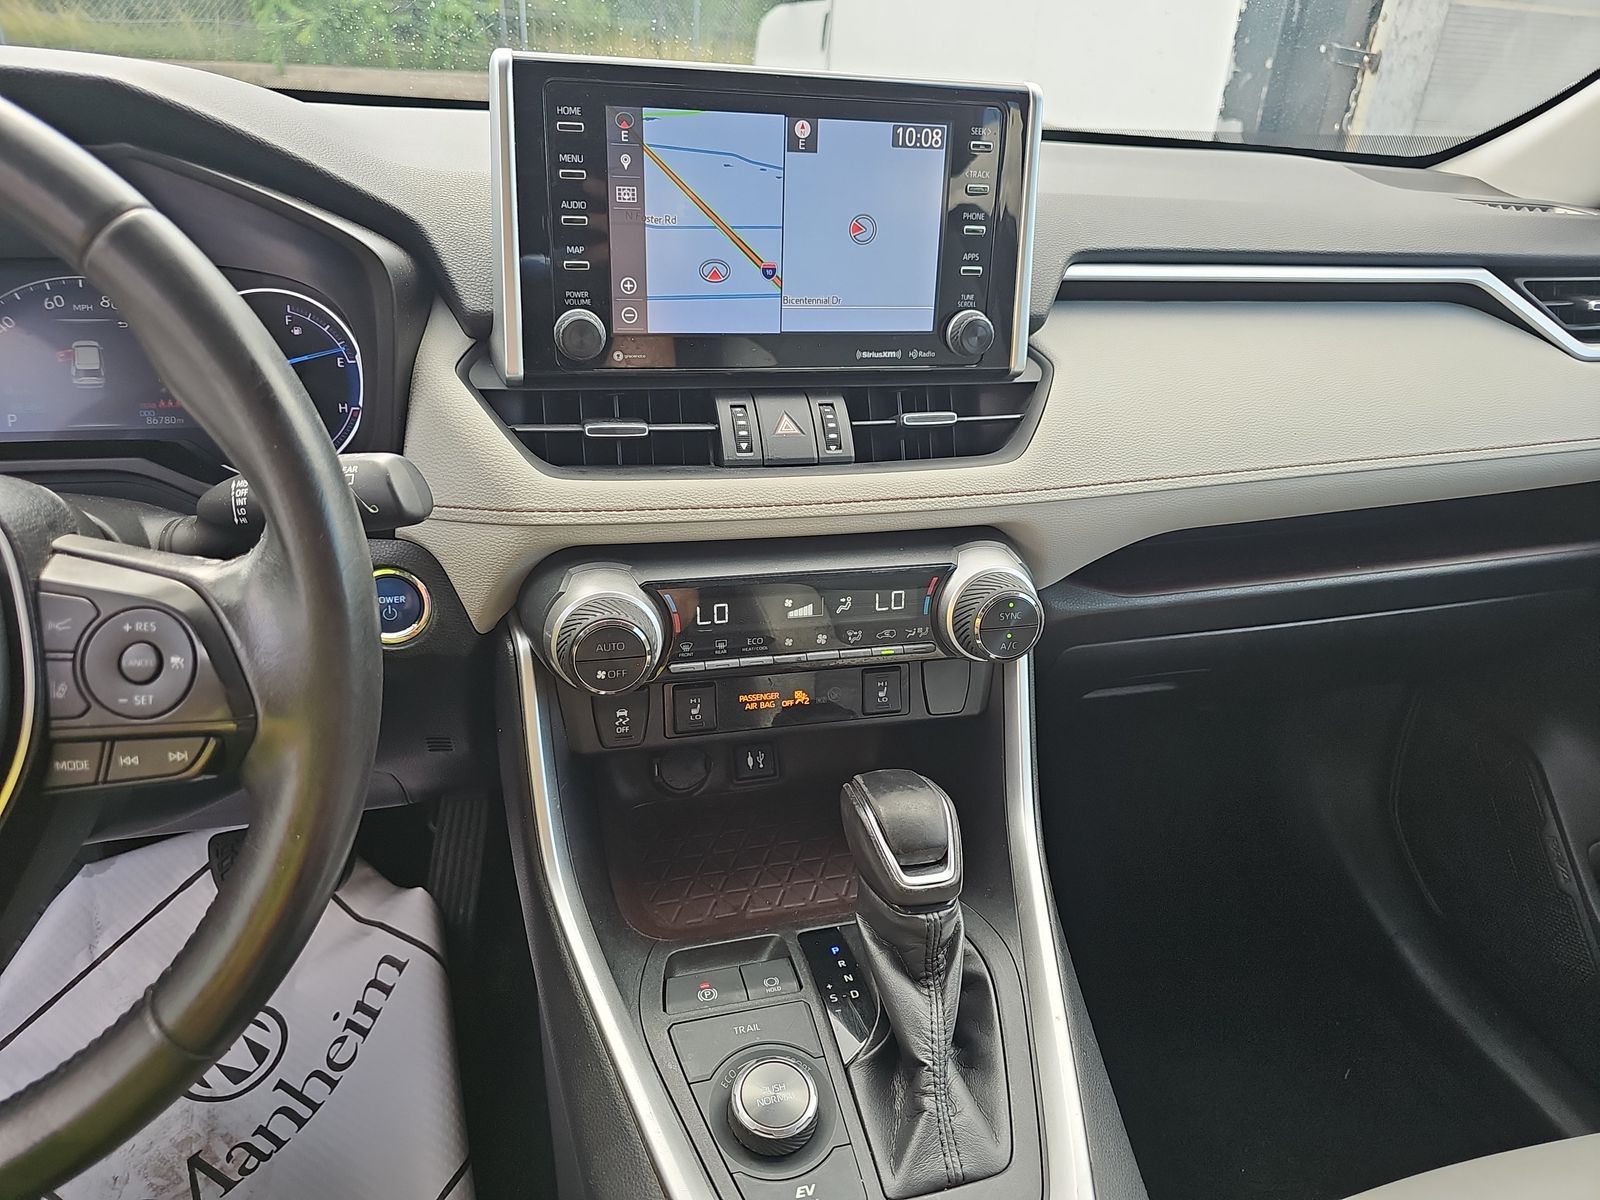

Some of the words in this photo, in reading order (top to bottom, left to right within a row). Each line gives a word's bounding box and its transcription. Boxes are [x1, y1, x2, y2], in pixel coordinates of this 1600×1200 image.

[556, 106, 582, 116] HOME
[621, 130, 629, 142] E
[896, 126, 943, 148] 10:08
[798, 139, 807, 150] E
[559, 153, 584, 163] MENU
[560, 200, 587, 210] AUDIO
[664, 215, 678, 225] Rd
[962, 212, 986, 221] PHONE
[566, 246, 585, 254] MAP
[962, 252, 980, 261] APPS
[765, 269, 773, 277] 10
[44, 295, 65, 310] 60
[564, 298, 592, 306] VOLUME
[782, 295, 831, 305] Bicentennial
[831, 296, 842, 305] Dr
[285, 315, 292, 325] F
[918, 350, 936, 358] Radio
[337, 357, 345, 368] E
[338, 403, 348, 414] H
[7, 414, 17, 427] P
[146, 417, 177, 425] 86780
[342, 465, 359, 474] EAR
[235, 488, 249, 497] OFF
[236, 497, 248, 506] INT
[236, 507, 247, 516] LO
[378, 595, 406, 604] OWER
[999, 611, 1022, 621] SYNC
[135, 621, 157, 632] RES
[747, 637, 764, 646] ECO
[1000, 641, 1018, 651] A/C
[595, 642, 625, 652] AUTO
[607, 670, 629, 679] OFF
[134, 695, 154, 705] SET
[738, 692, 780, 702] PASSENGER
[744, 702, 758, 710] AIR
[760, 701, 776, 709] BAG
[781, 699, 794, 708] OFF
[616, 726, 630, 734] OFF
[54, 760, 90, 771] MODE
[830, 946, 840, 955] P
[838, 959, 847, 968] R
[844, 974, 854, 983] N
[829, 993, 838, 1003] S
[850, 989, 860, 999] D
[733, 1023, 761, 1035] TRAIL
[720, 1069, 737, 1089] ECO
[756, 1093, 795, 1107] NORMA
[795, 1183, 816, 1199] EV
